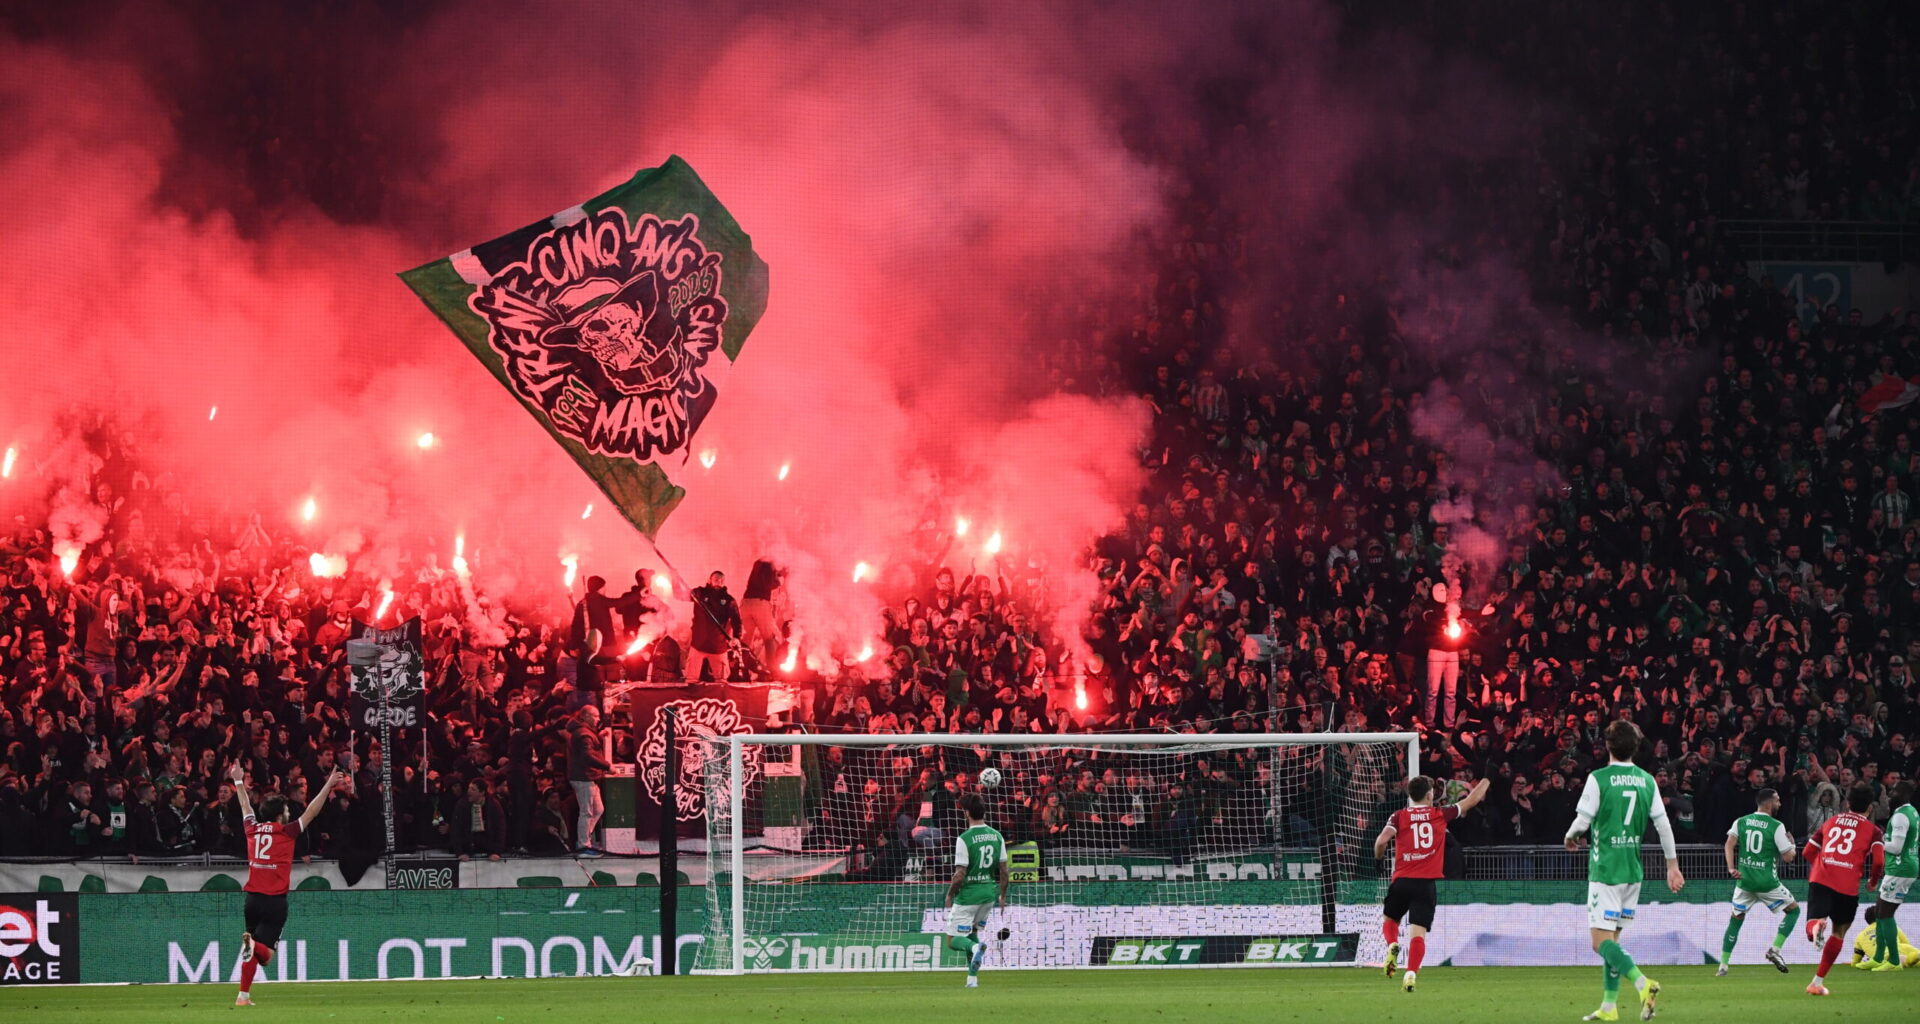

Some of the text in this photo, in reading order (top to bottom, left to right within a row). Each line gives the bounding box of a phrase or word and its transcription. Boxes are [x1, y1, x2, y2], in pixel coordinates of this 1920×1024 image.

[630, 223, 696, 281] ANS
[1410, 813, 1430, 821] BINET
[1622, 790, 1637, 825] 7
[1835, 817, 1858, 827] FATAR
[254, 833, 273, 860] 12
[1410, 822, 1434, 849] 19
[1745, 829, 1763, 854] 10
[1824, 827, 1857, 855] 23
[979, 844, 994, 869] 13
[395, 867, 453, 889] AVEC
[791, 935, 942, 969] hummel
[1111, 942, 1337, 961] BKT BKT
